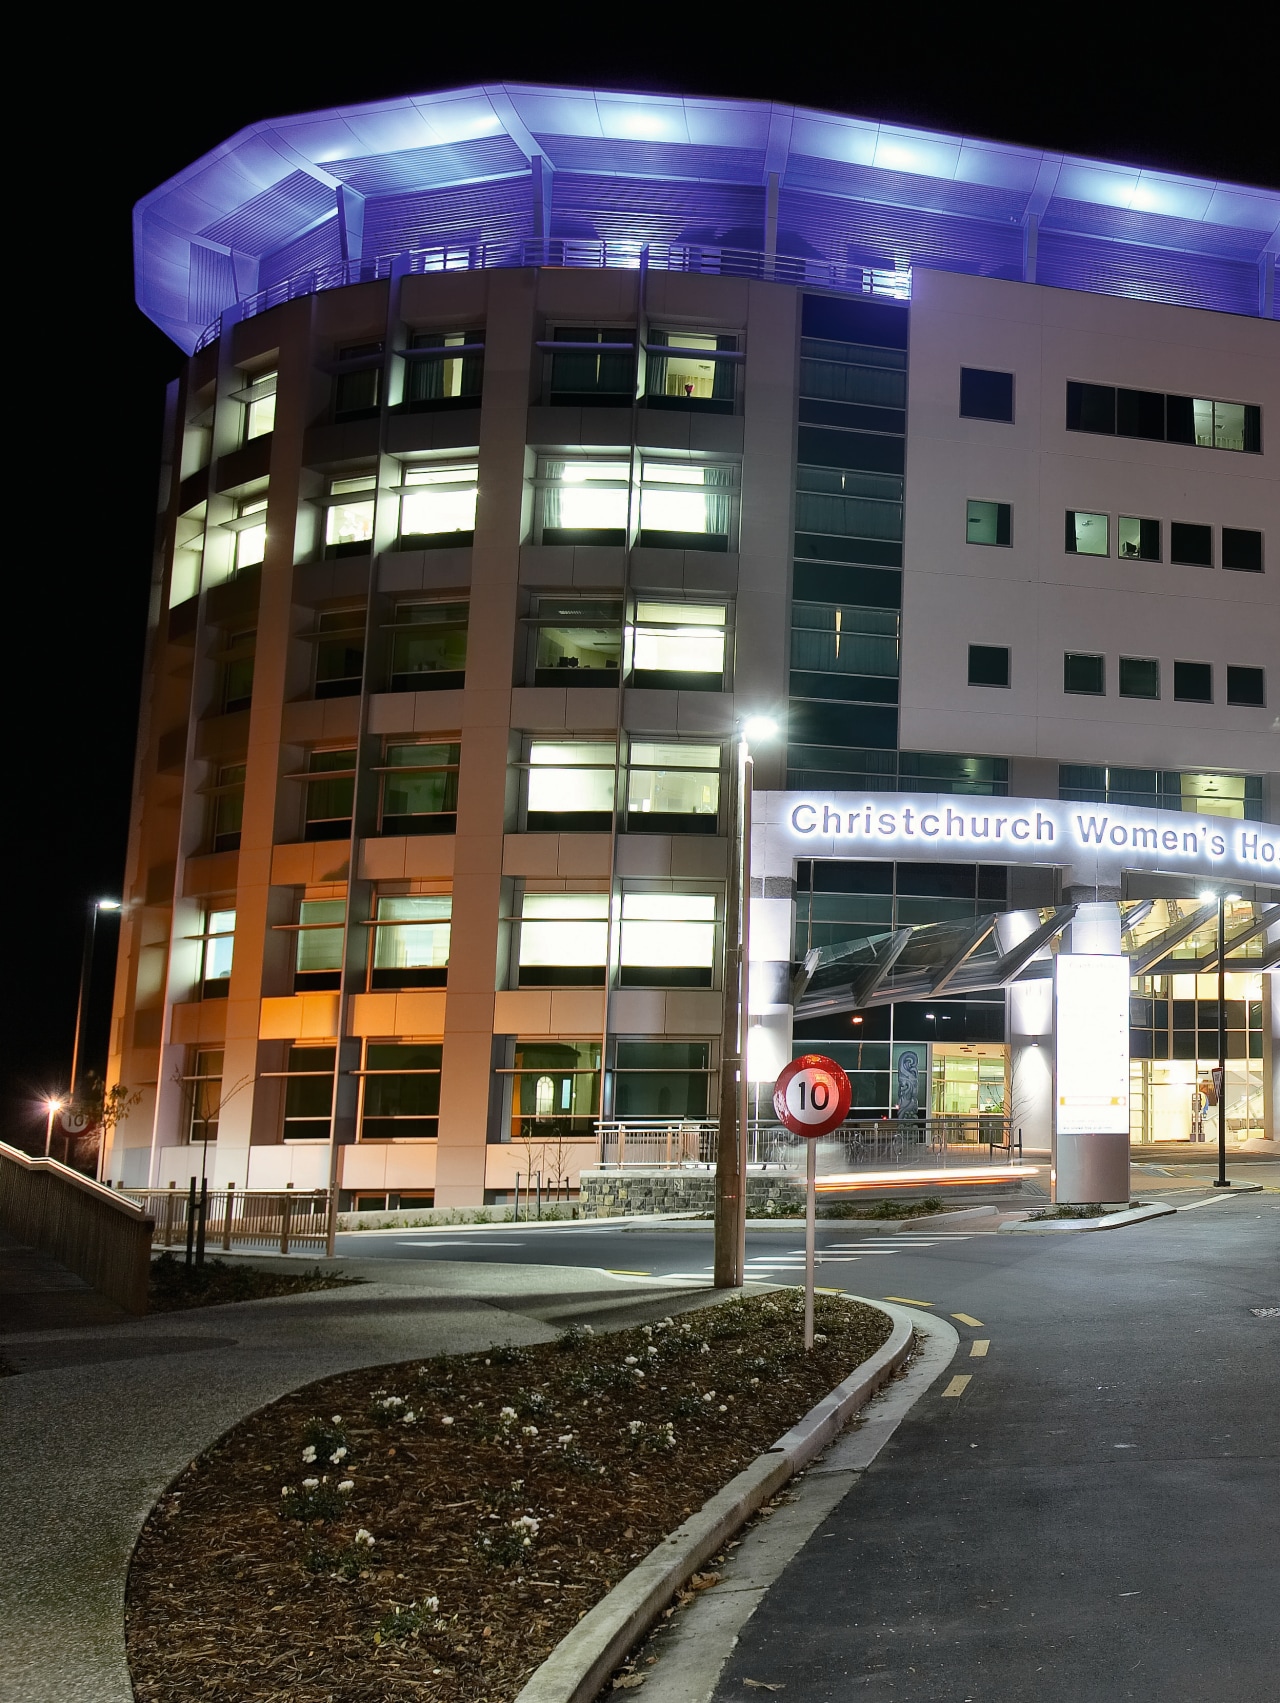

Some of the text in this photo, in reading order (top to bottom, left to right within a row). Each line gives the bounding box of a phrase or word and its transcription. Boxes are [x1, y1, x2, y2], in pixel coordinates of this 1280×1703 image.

[791, 804, 1054, 841] Christchurch
[1076, 815, 1225, 856] Women's
[798, 1081, 829, 1110] 10
